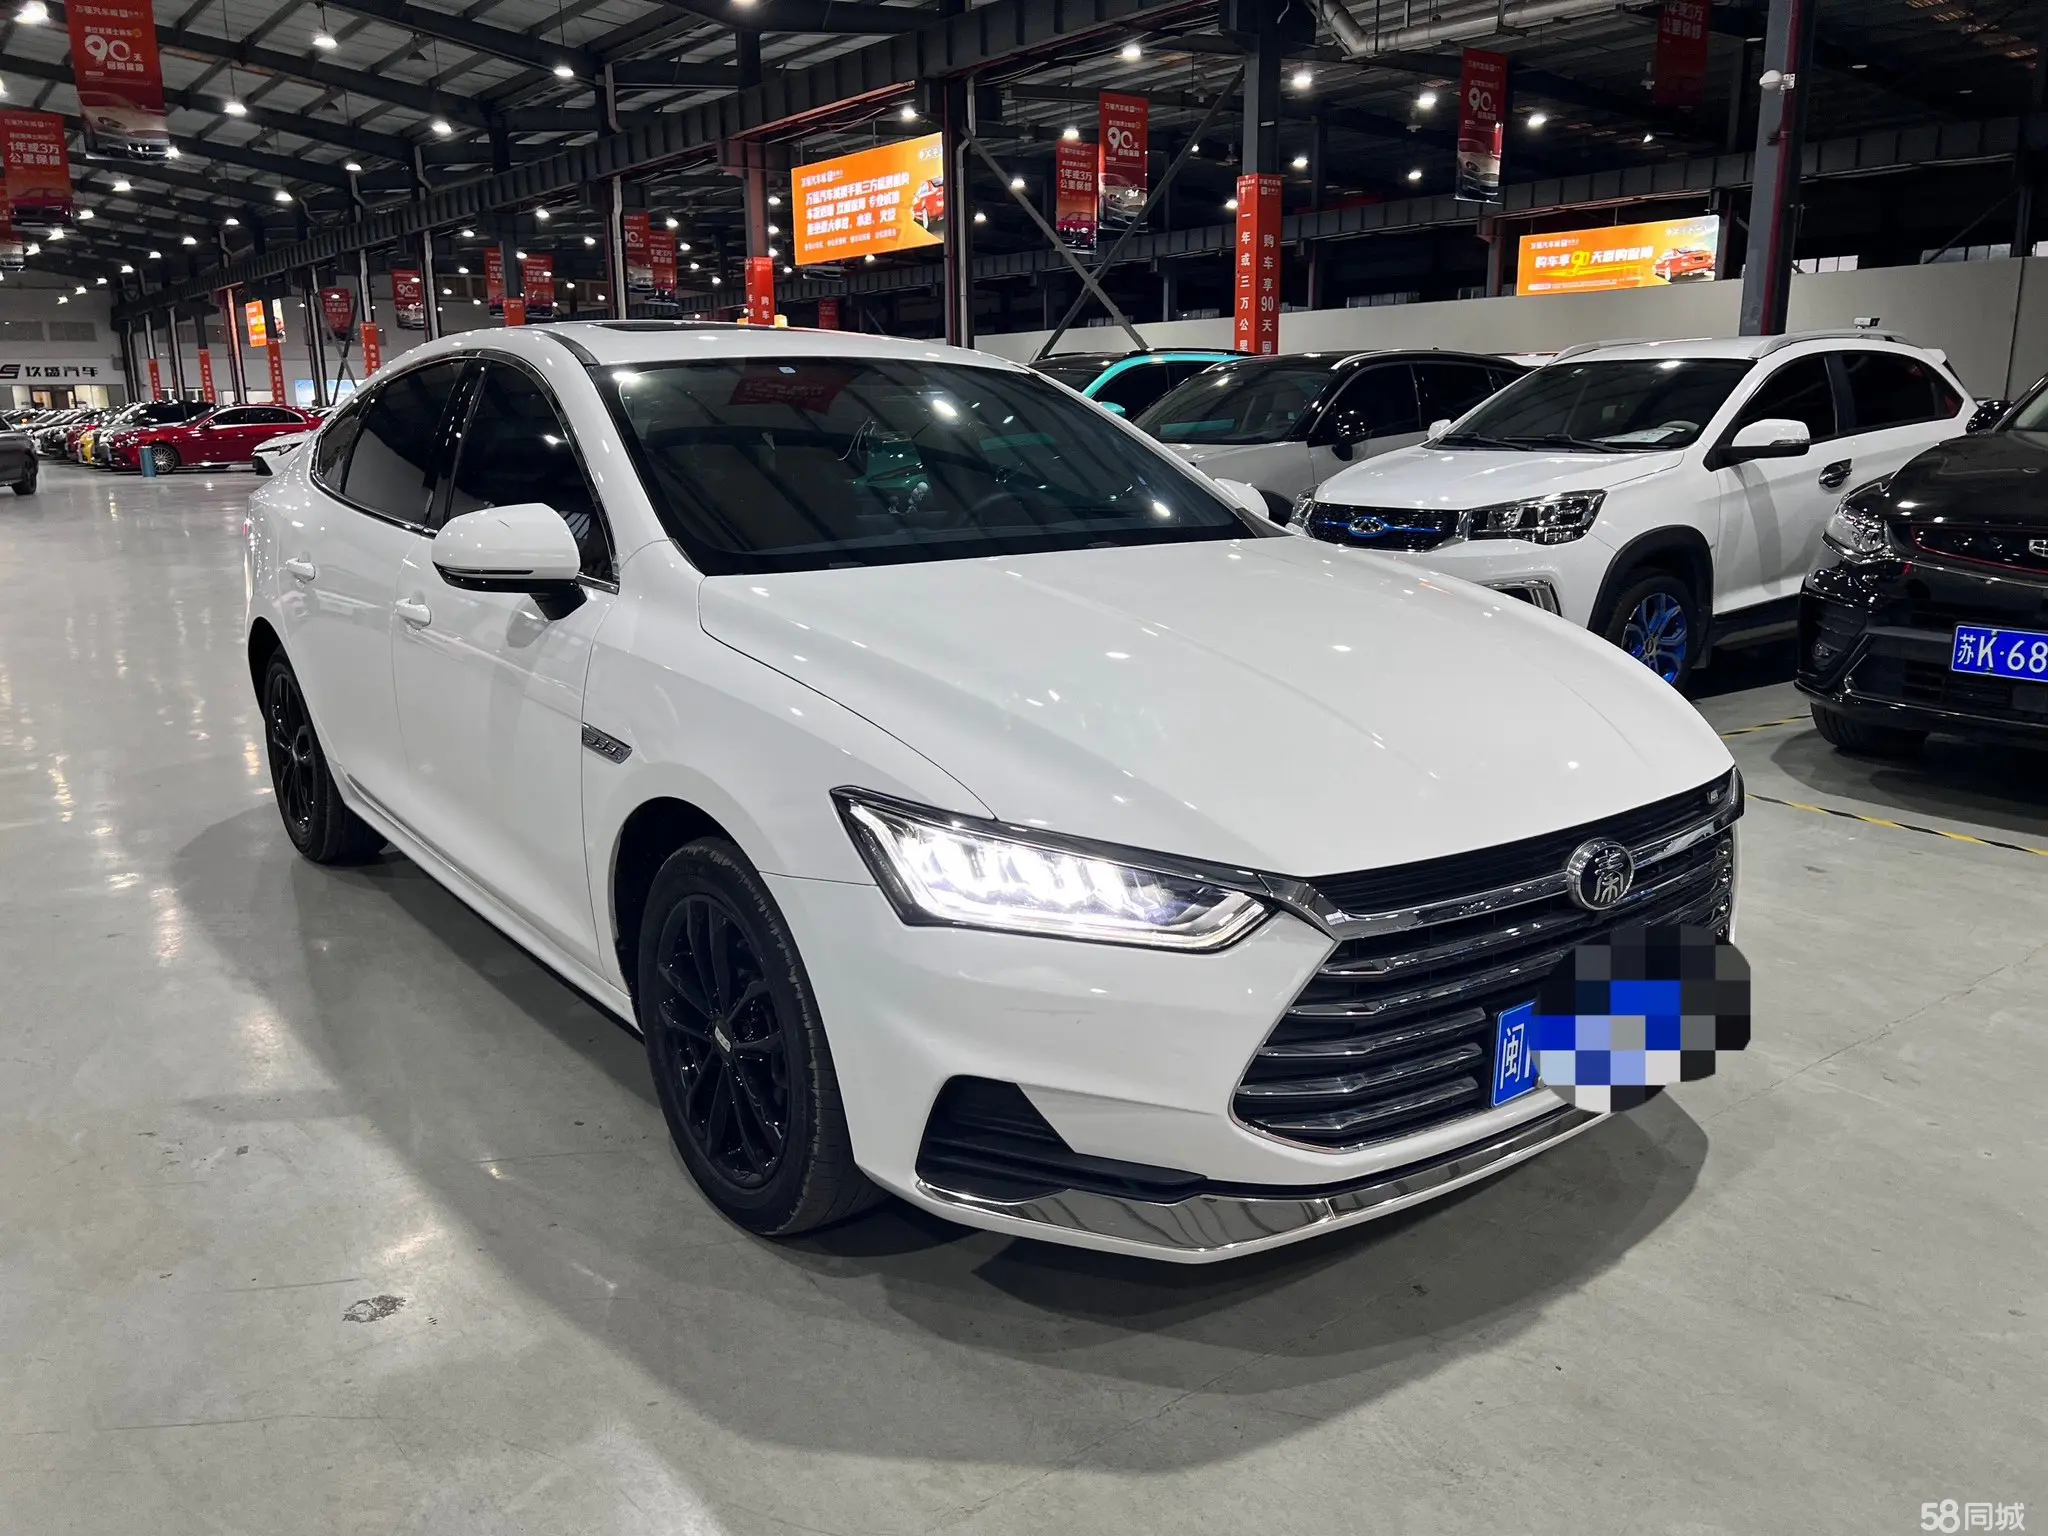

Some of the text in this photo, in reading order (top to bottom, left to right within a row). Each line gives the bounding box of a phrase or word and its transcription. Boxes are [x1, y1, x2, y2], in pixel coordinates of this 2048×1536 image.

[1239, 213, 1252, 352] 一年或三万公里
